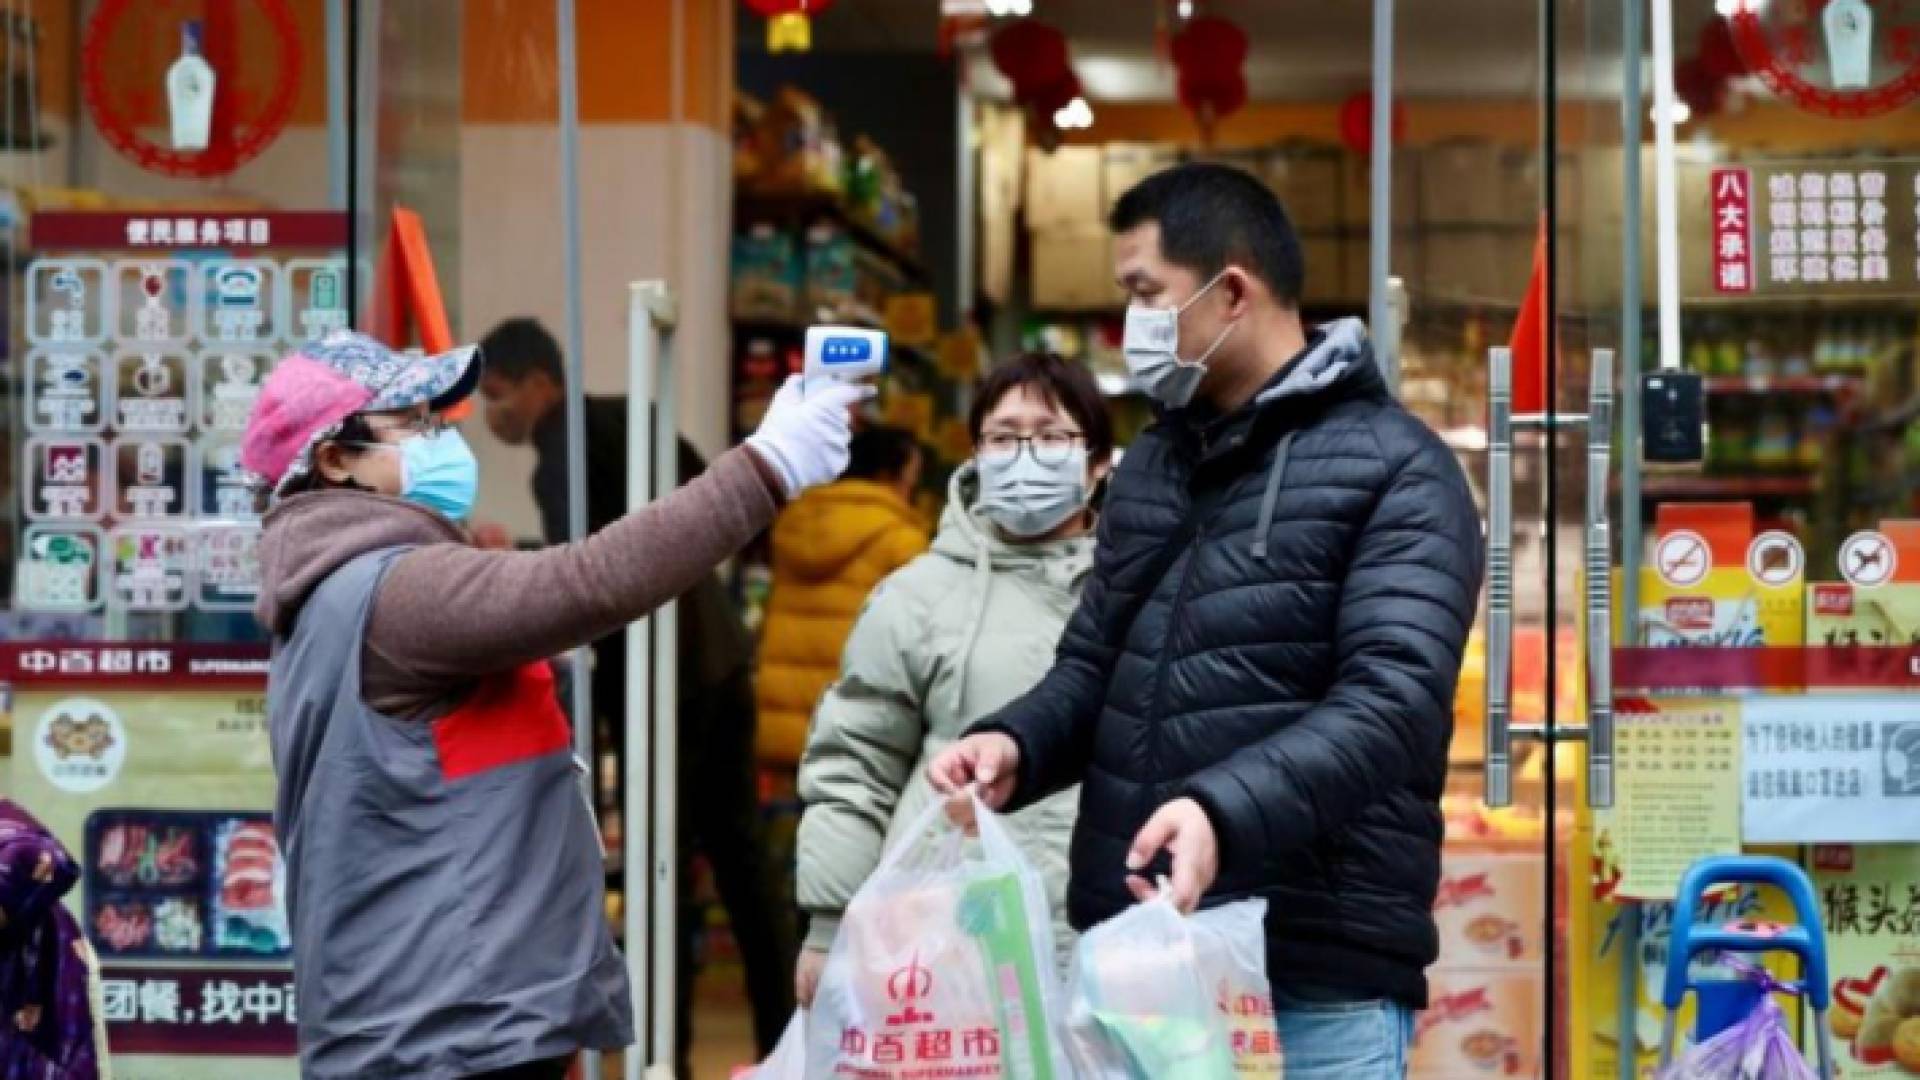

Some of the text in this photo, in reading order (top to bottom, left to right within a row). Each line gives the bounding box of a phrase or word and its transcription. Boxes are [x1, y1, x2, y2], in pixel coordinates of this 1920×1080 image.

[127, 219, 269, 245] 便民服务项目
[1717, 173, 1746, 289] 八大承诺
[19, 650, 171, 673] 中百超市
[841, 1026, 1000, 1063] 中百超市
